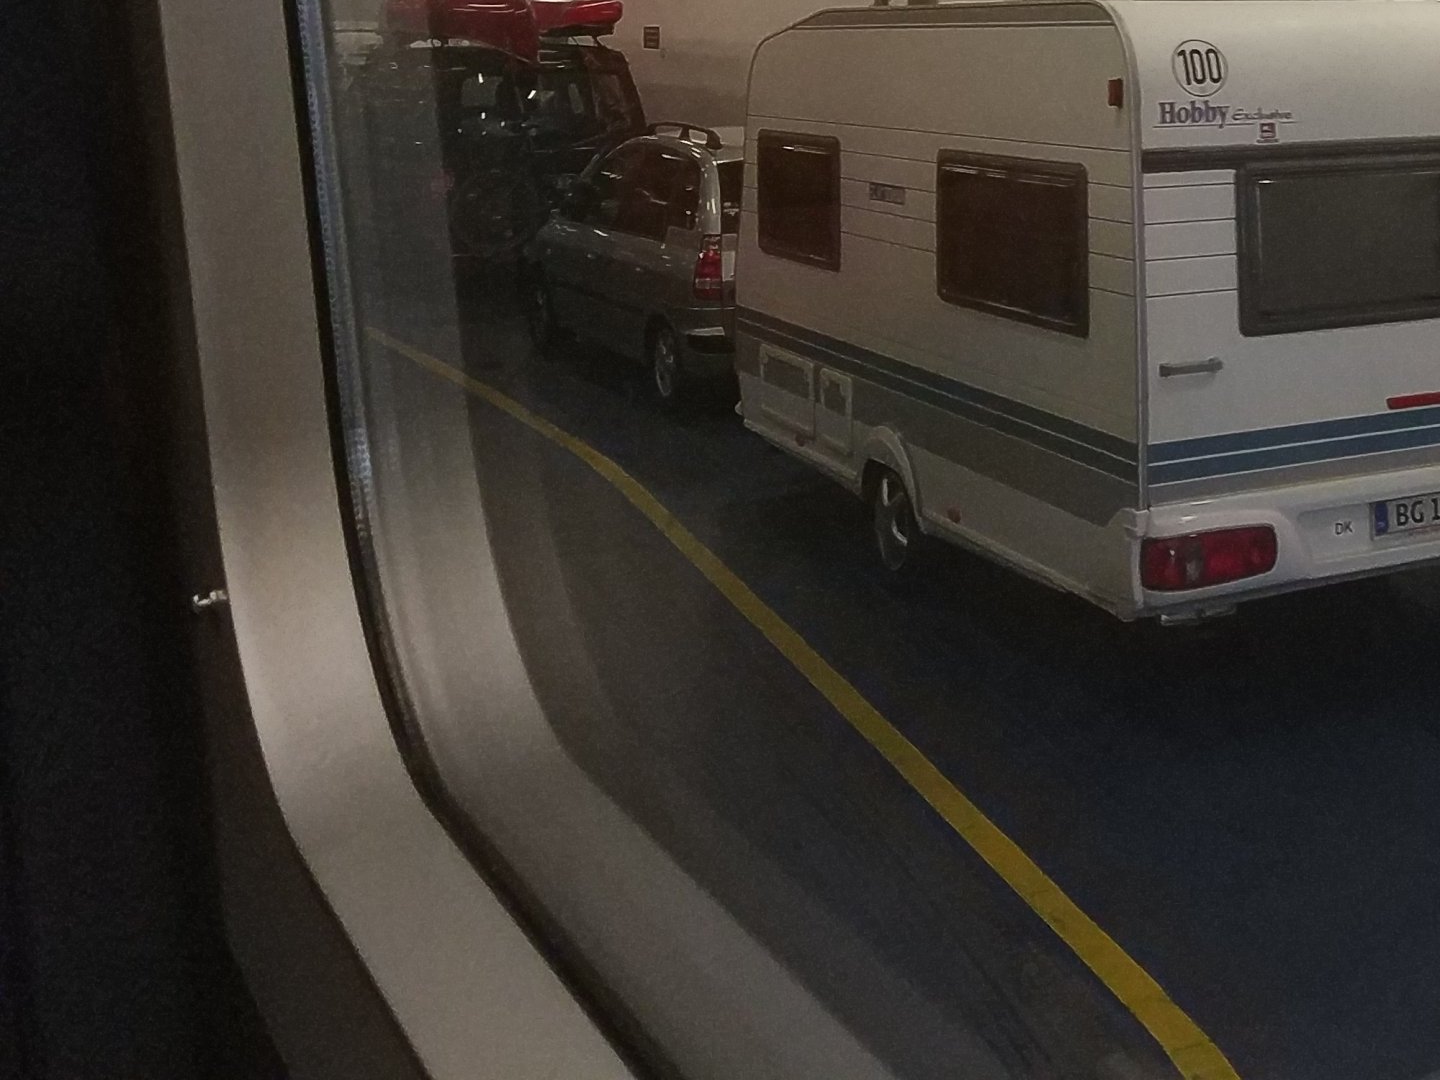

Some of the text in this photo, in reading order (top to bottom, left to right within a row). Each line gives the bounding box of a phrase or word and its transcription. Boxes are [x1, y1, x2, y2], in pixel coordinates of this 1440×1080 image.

[1177, 48, 1222, 86] 100
[1158, 100, 1230, 129] Hobby
[1396, 501, 1425, 527] BG
[1334, 522, 1353, 536] DK
